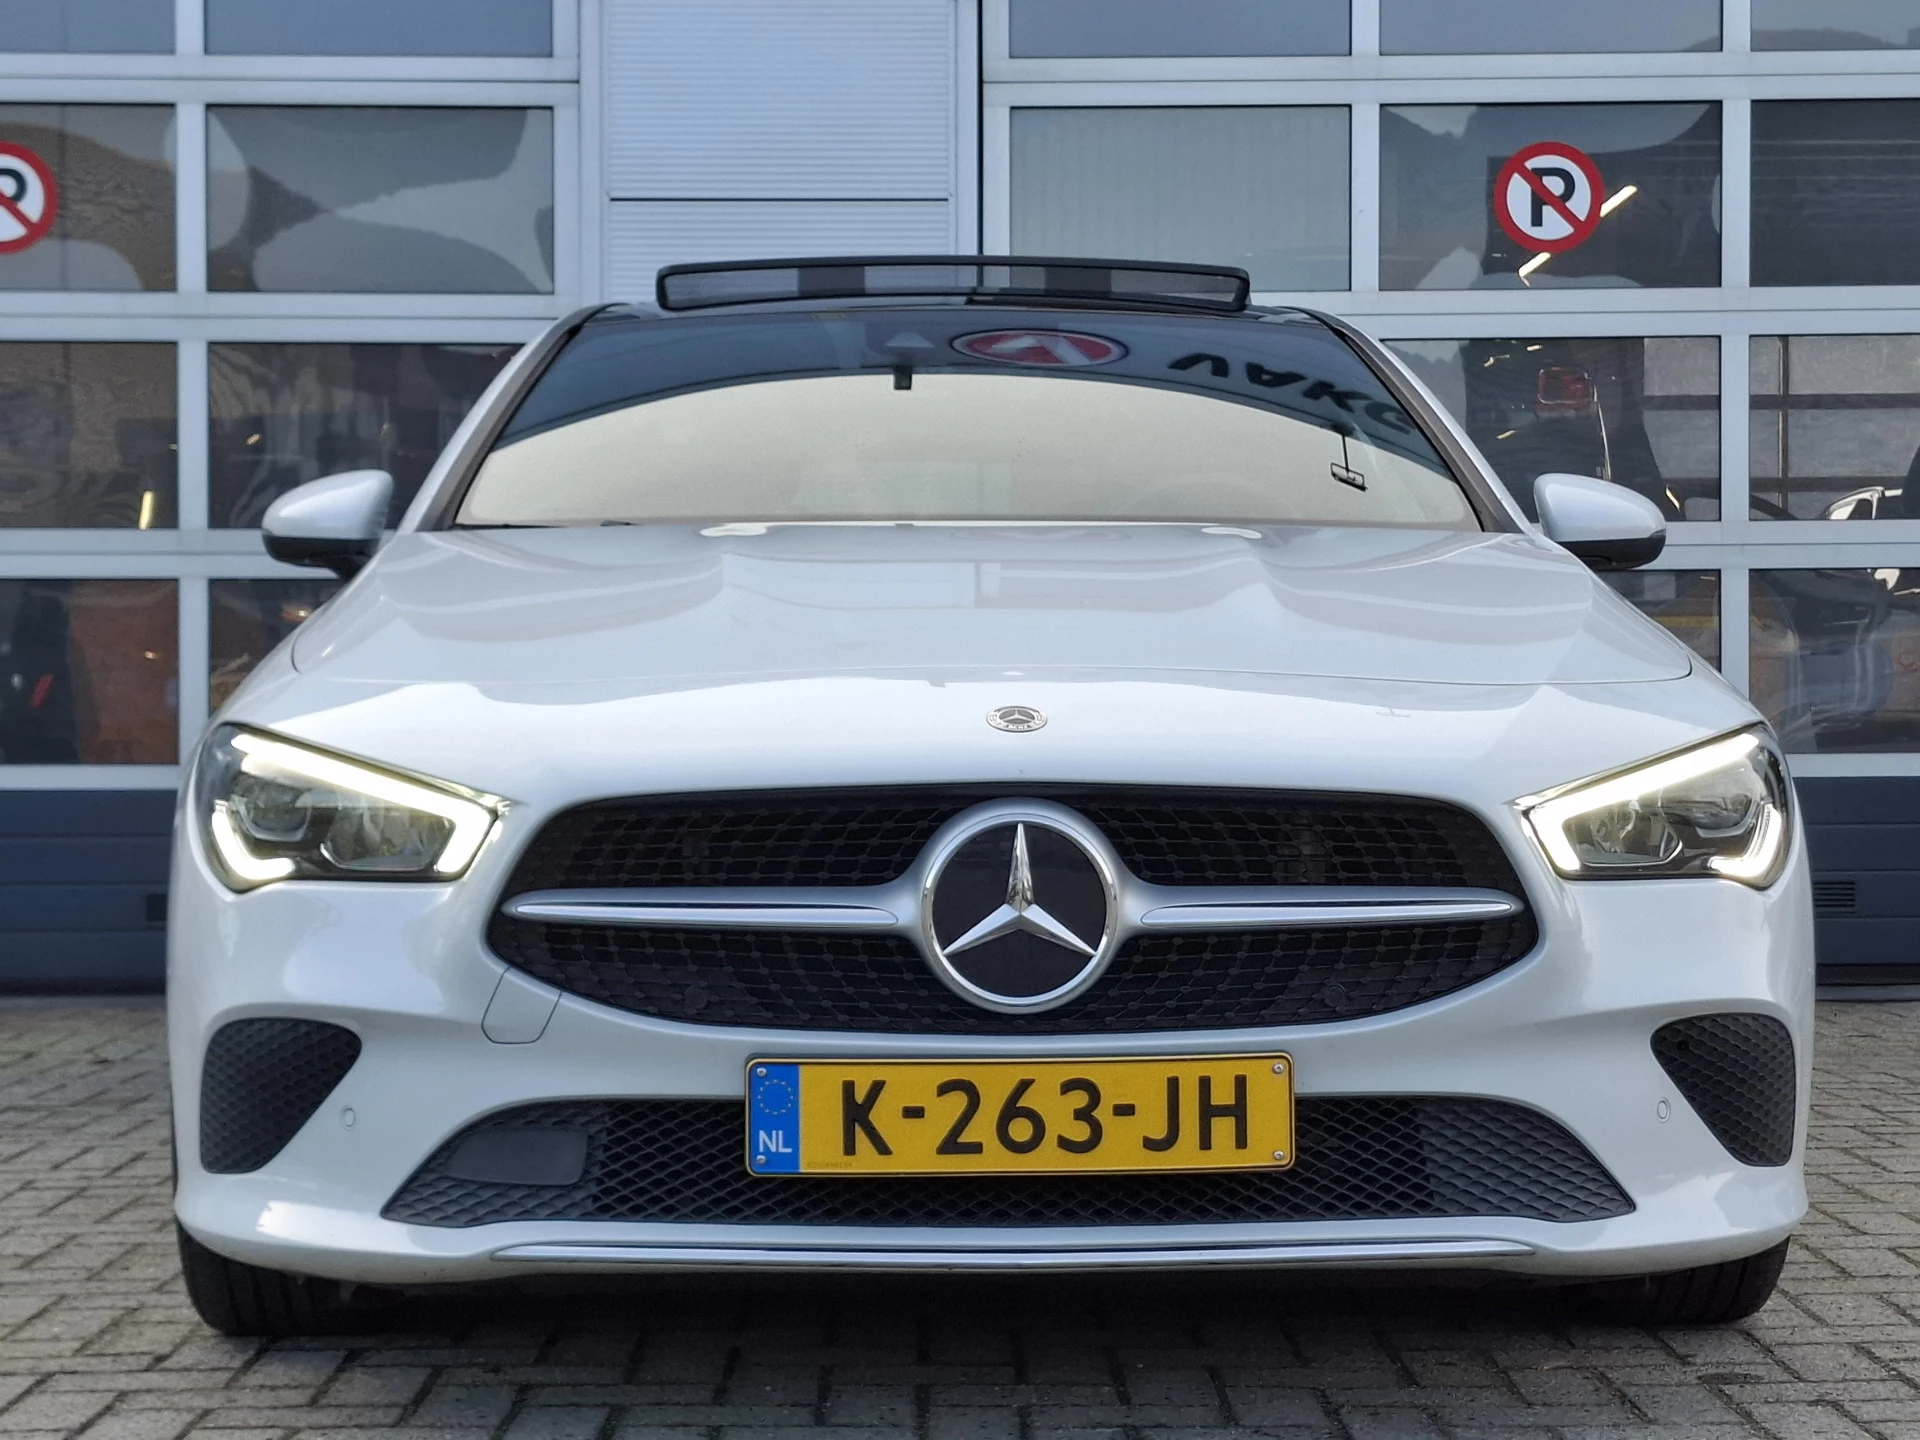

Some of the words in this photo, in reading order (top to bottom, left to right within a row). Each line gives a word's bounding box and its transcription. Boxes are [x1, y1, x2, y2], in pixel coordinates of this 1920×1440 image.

[1531, 167, 1575, 227] P
[759, 1130, 792, 1152] NL
[842, 1074, 1247, 1155] K-263-JH
